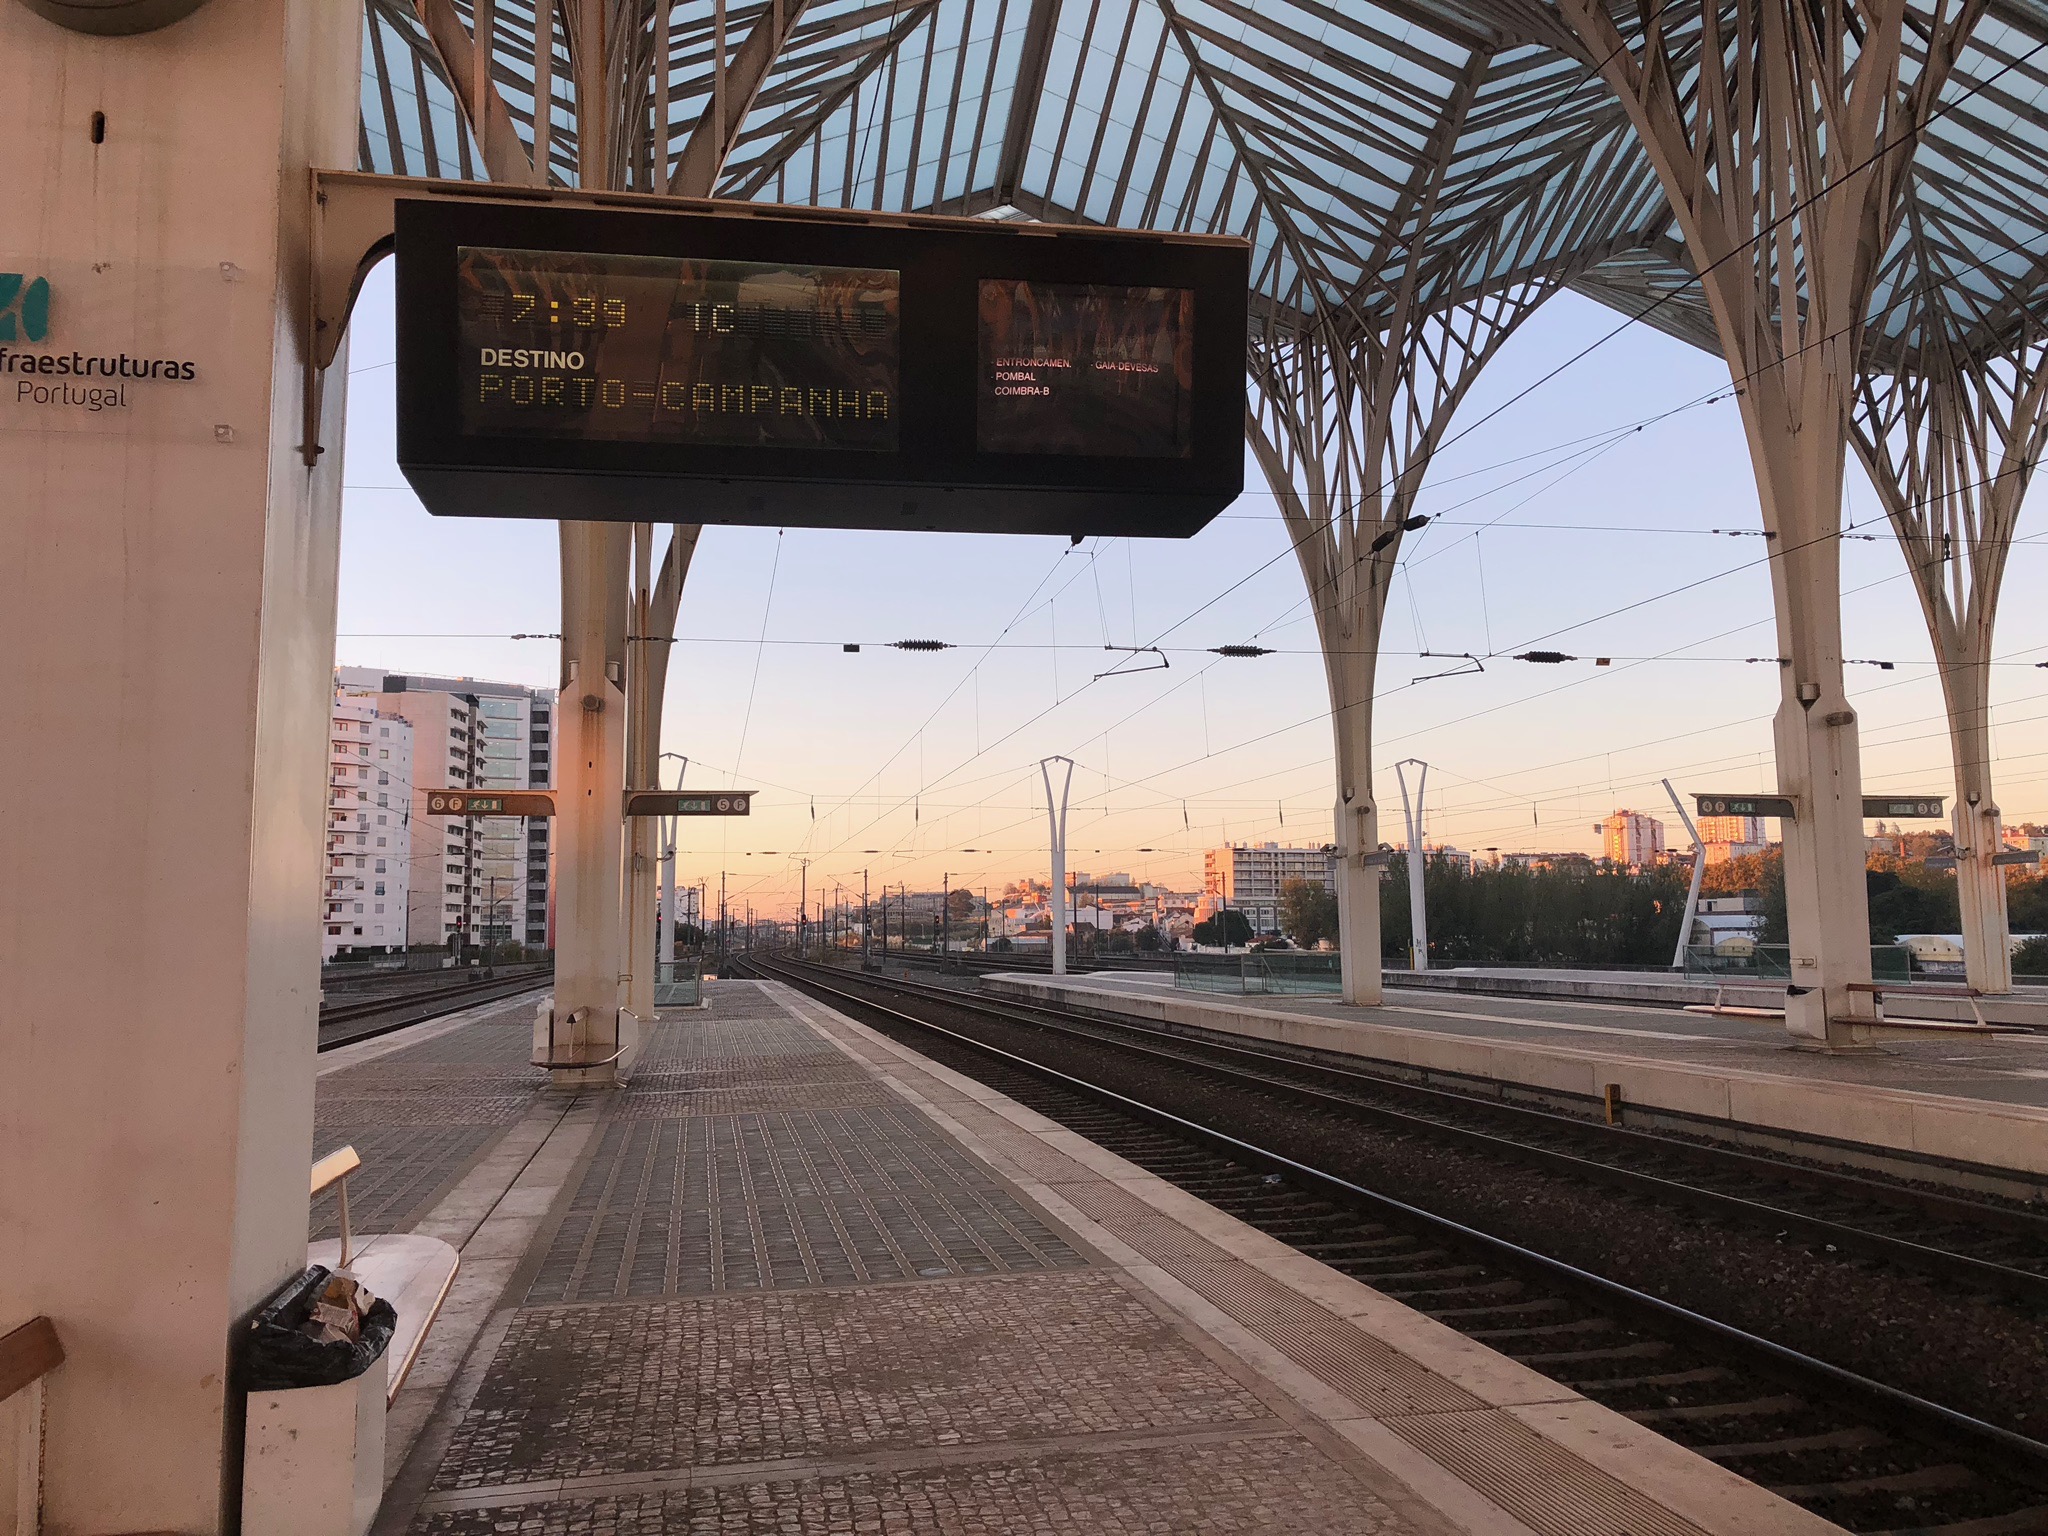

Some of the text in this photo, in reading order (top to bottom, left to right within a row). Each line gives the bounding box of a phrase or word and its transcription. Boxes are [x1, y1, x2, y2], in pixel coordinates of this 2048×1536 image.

[512, 294, 735, 332] 7:39 IC
[480, 348, 585, 370] DESTINO
[996, 357, 1072, 368] ENTRONCAMEN.
[1095, 360, 1159, 373] GAIA-DEVESAS
[996, 371, 1036, 381] POMBAL
[17, 380, 127, 412] Portugal
[480, 374, 889, 419] PORTO-CAMPANHA
[994, 386, 1050, 396] COIMBRA-B
